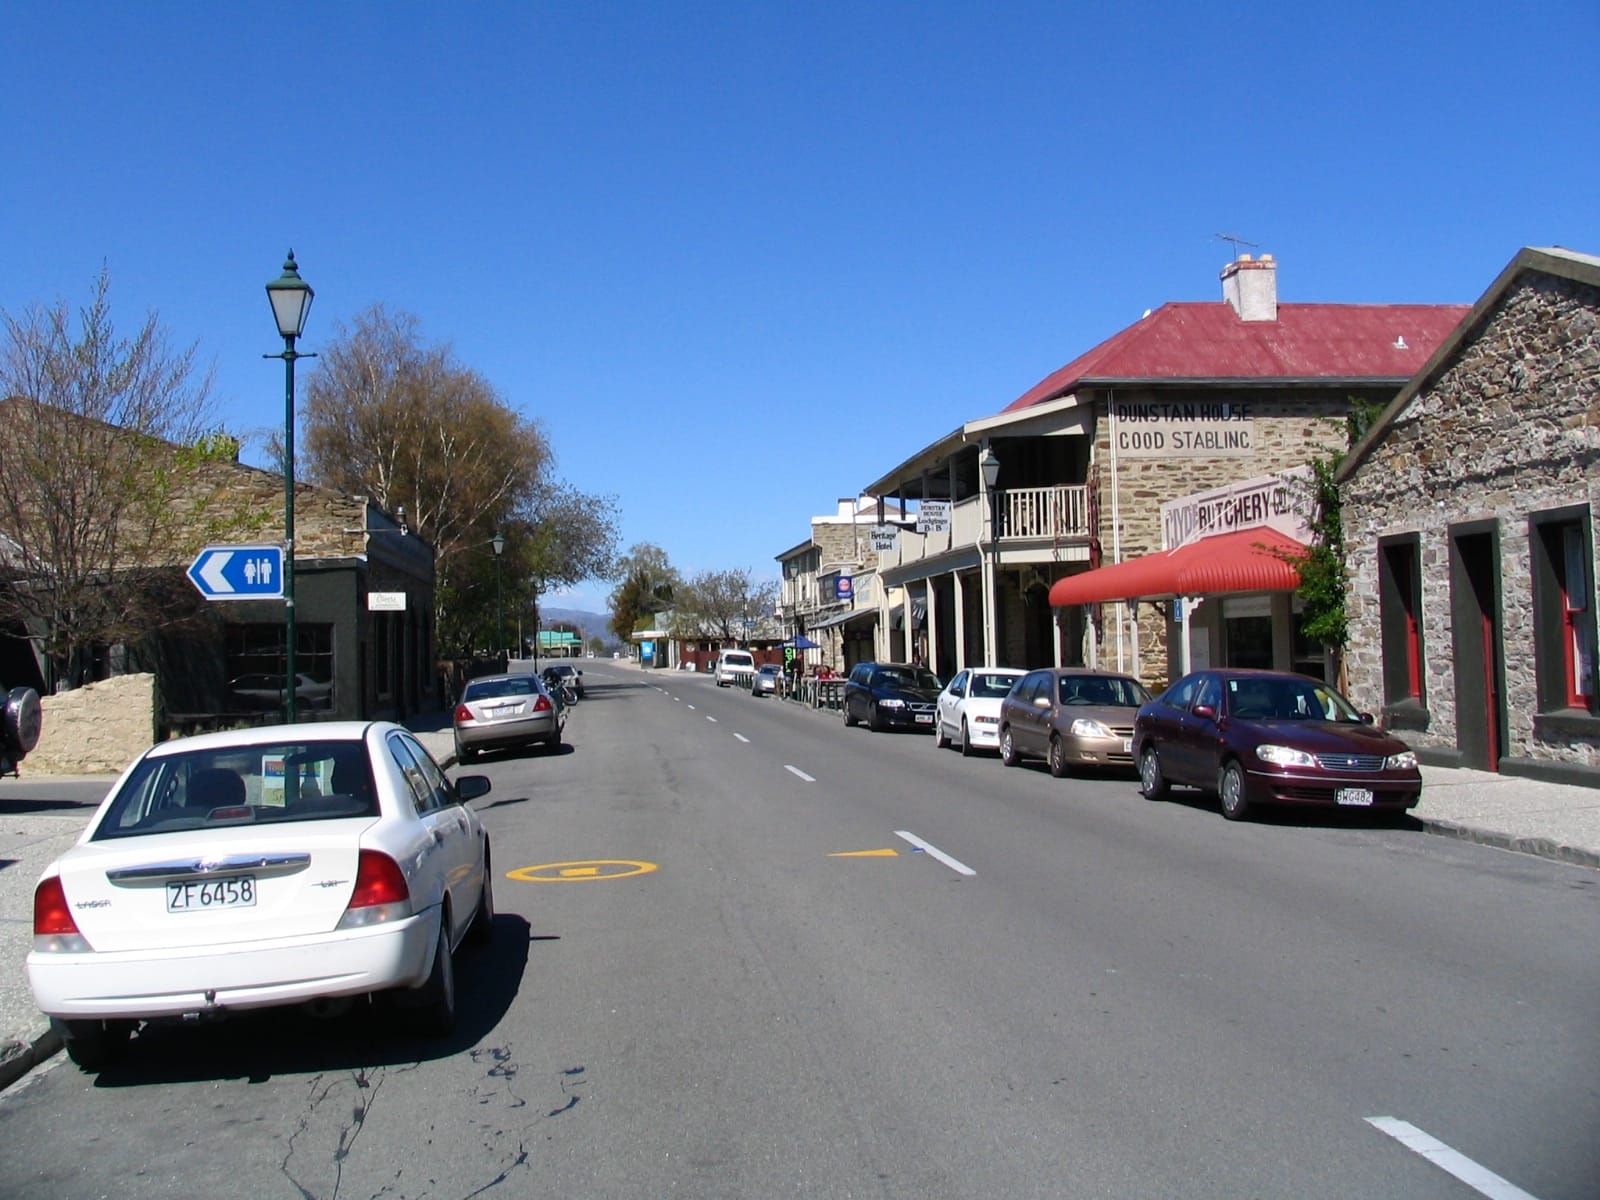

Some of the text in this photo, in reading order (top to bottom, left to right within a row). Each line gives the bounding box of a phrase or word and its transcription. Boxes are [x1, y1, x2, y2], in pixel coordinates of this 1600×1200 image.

[1118, 402, 1253, 423] DUNSTAN HOUSE
[1199, 490, 1270, 530] BUTCHERY
[871, 530, 897, 541] Heritage
[875, 541, 893, 551] Hotel
[170, 879, 254, 908] ZF6458
